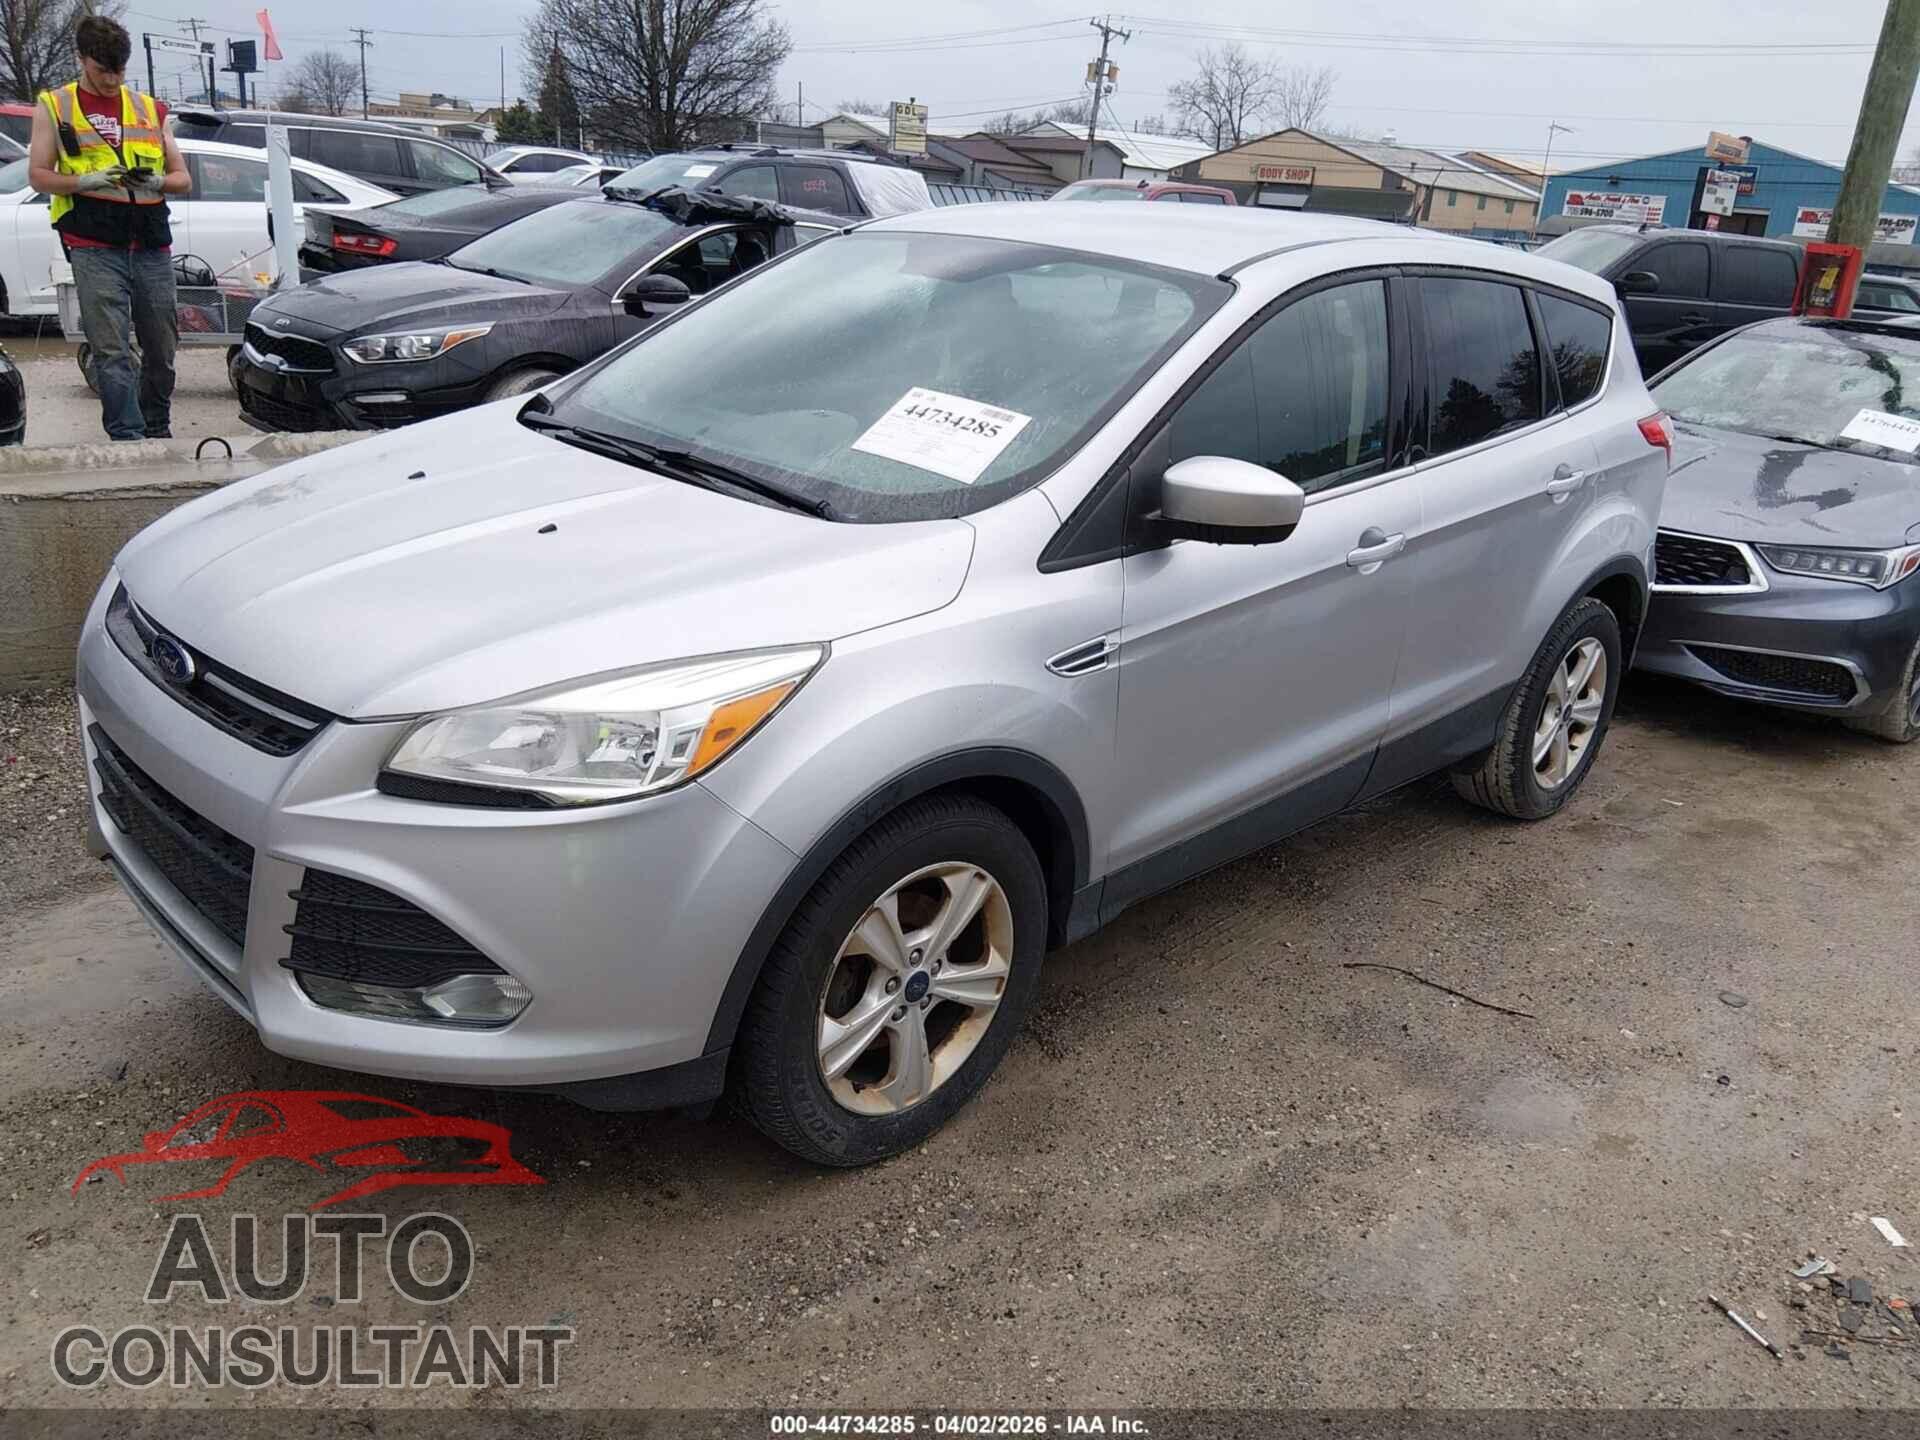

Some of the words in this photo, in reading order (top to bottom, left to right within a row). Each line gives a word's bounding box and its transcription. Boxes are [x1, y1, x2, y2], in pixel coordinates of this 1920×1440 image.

[1259, 166, 1284, 179] BODY
[1285, 168, 1311, 181] SHOP
[903, 404, 1003, 439] 44734285
